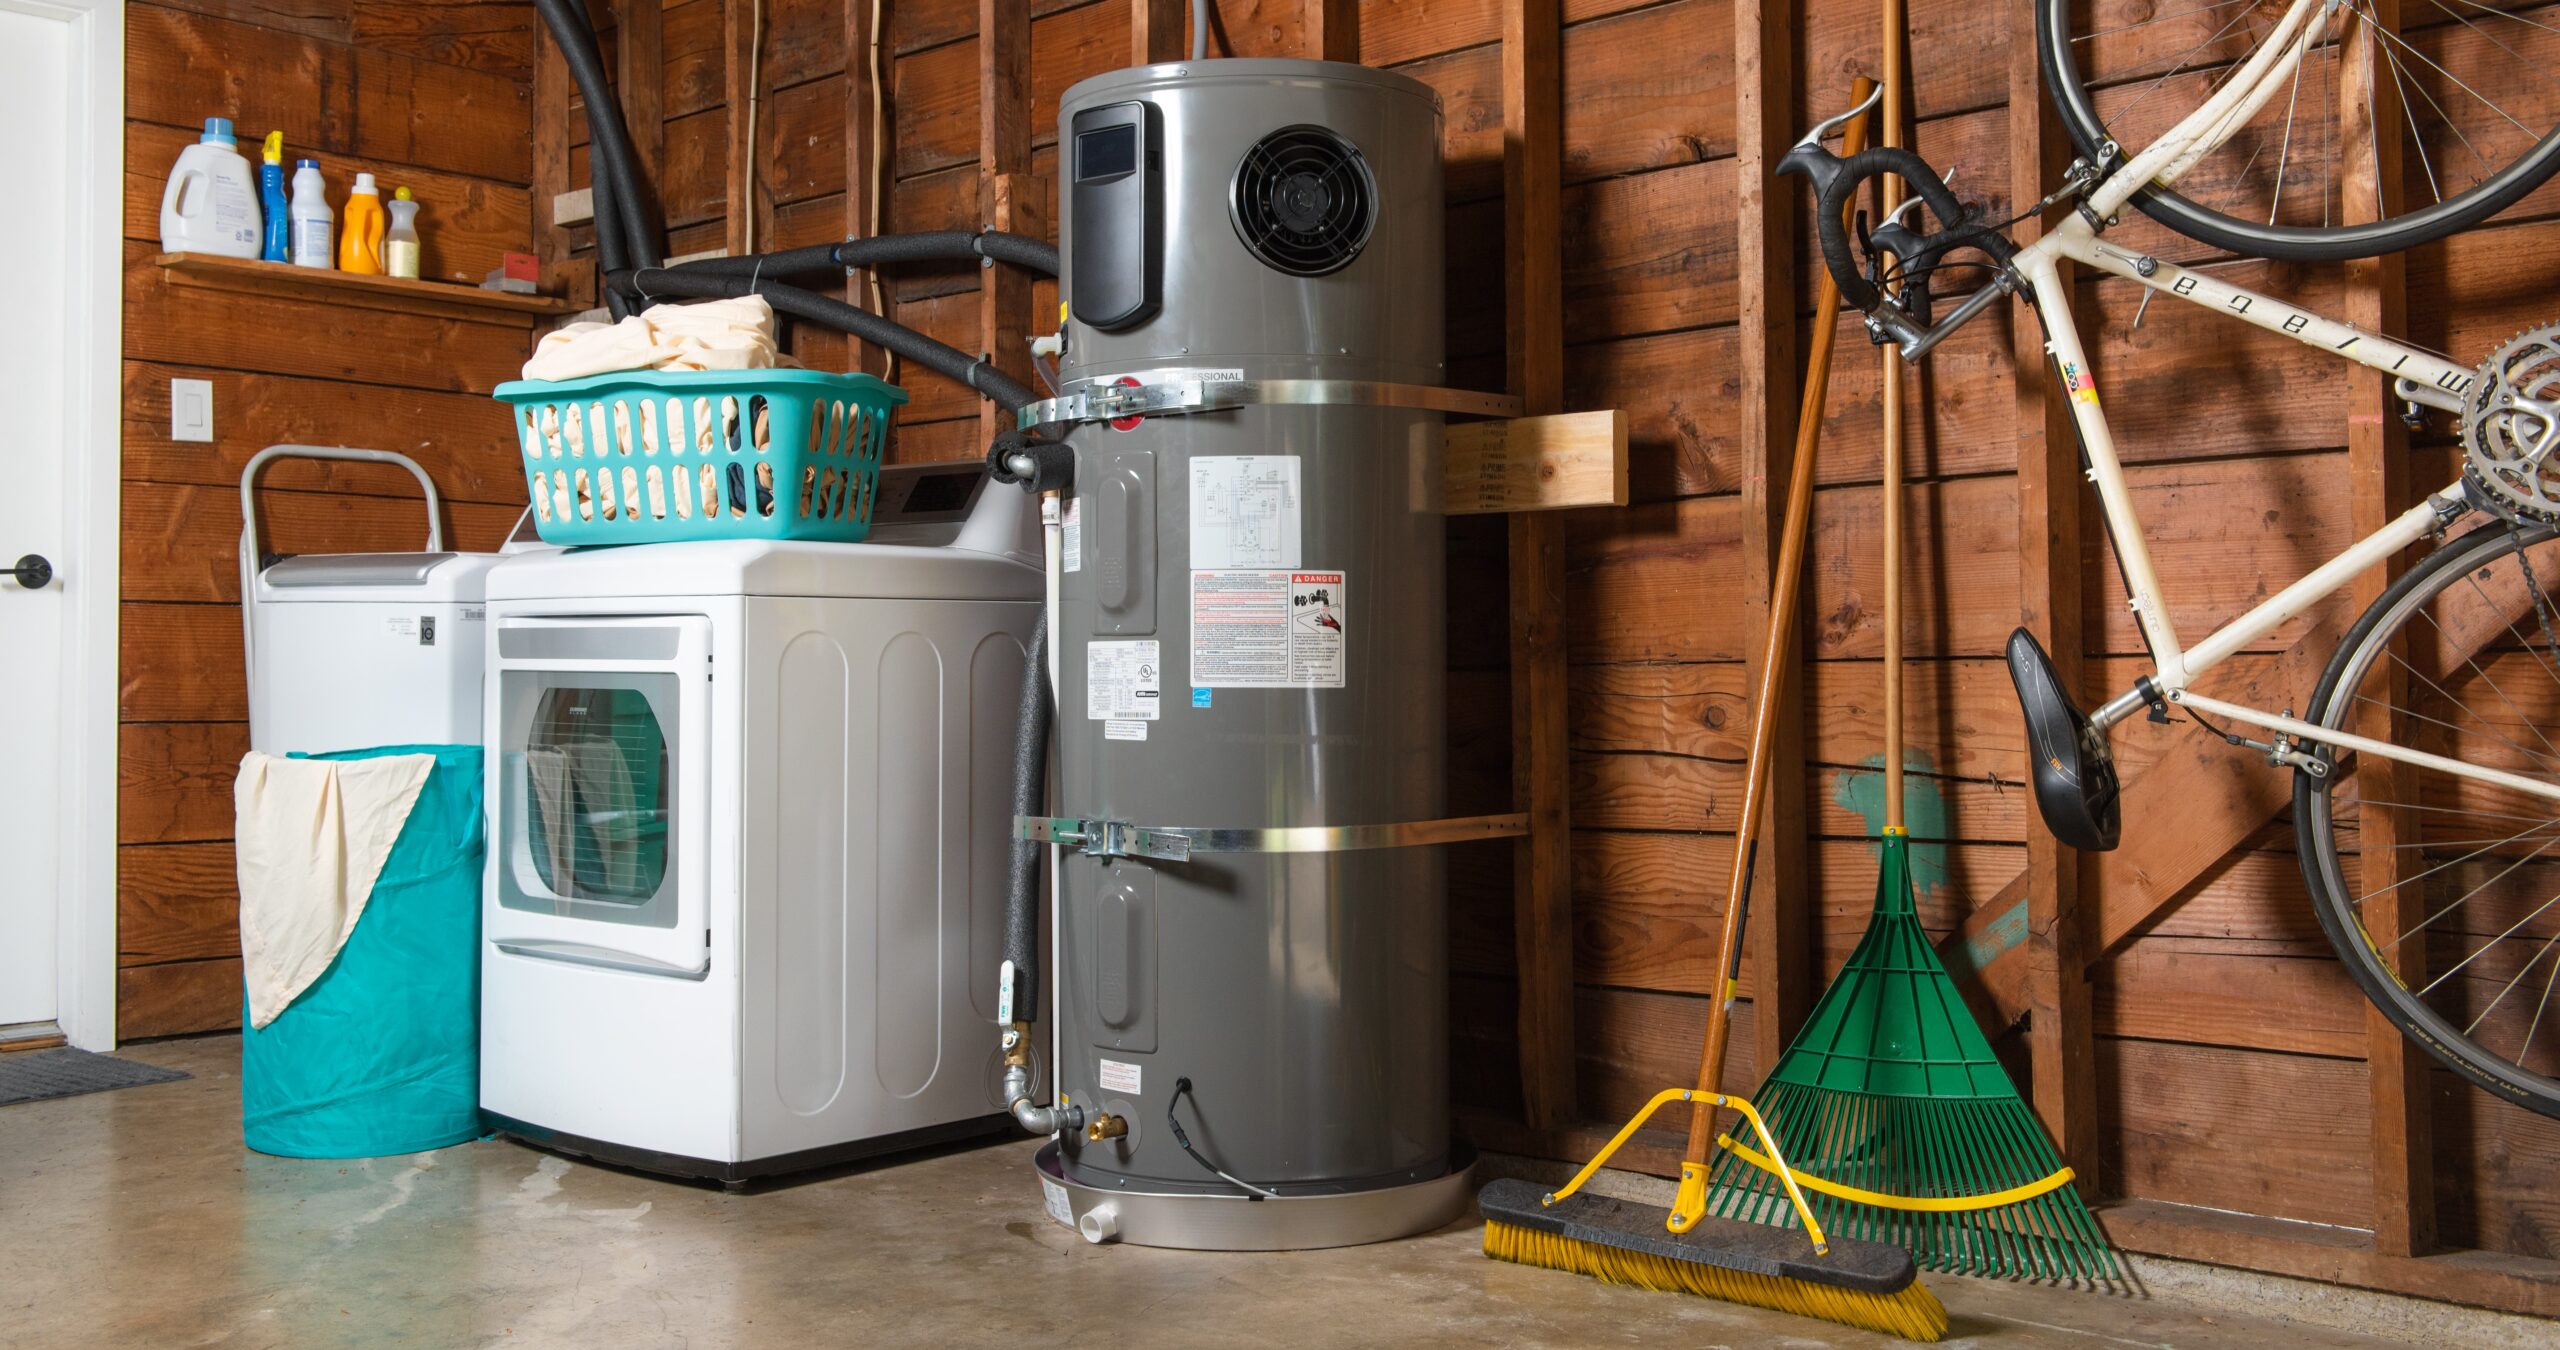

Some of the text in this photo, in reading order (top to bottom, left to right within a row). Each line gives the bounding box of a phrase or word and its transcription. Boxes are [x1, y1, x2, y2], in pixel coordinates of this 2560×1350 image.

[1304, 575, 1339, 583] DANGER
[2406, 1022, 2529, 1096] ANTI PUNCTURE BELT
